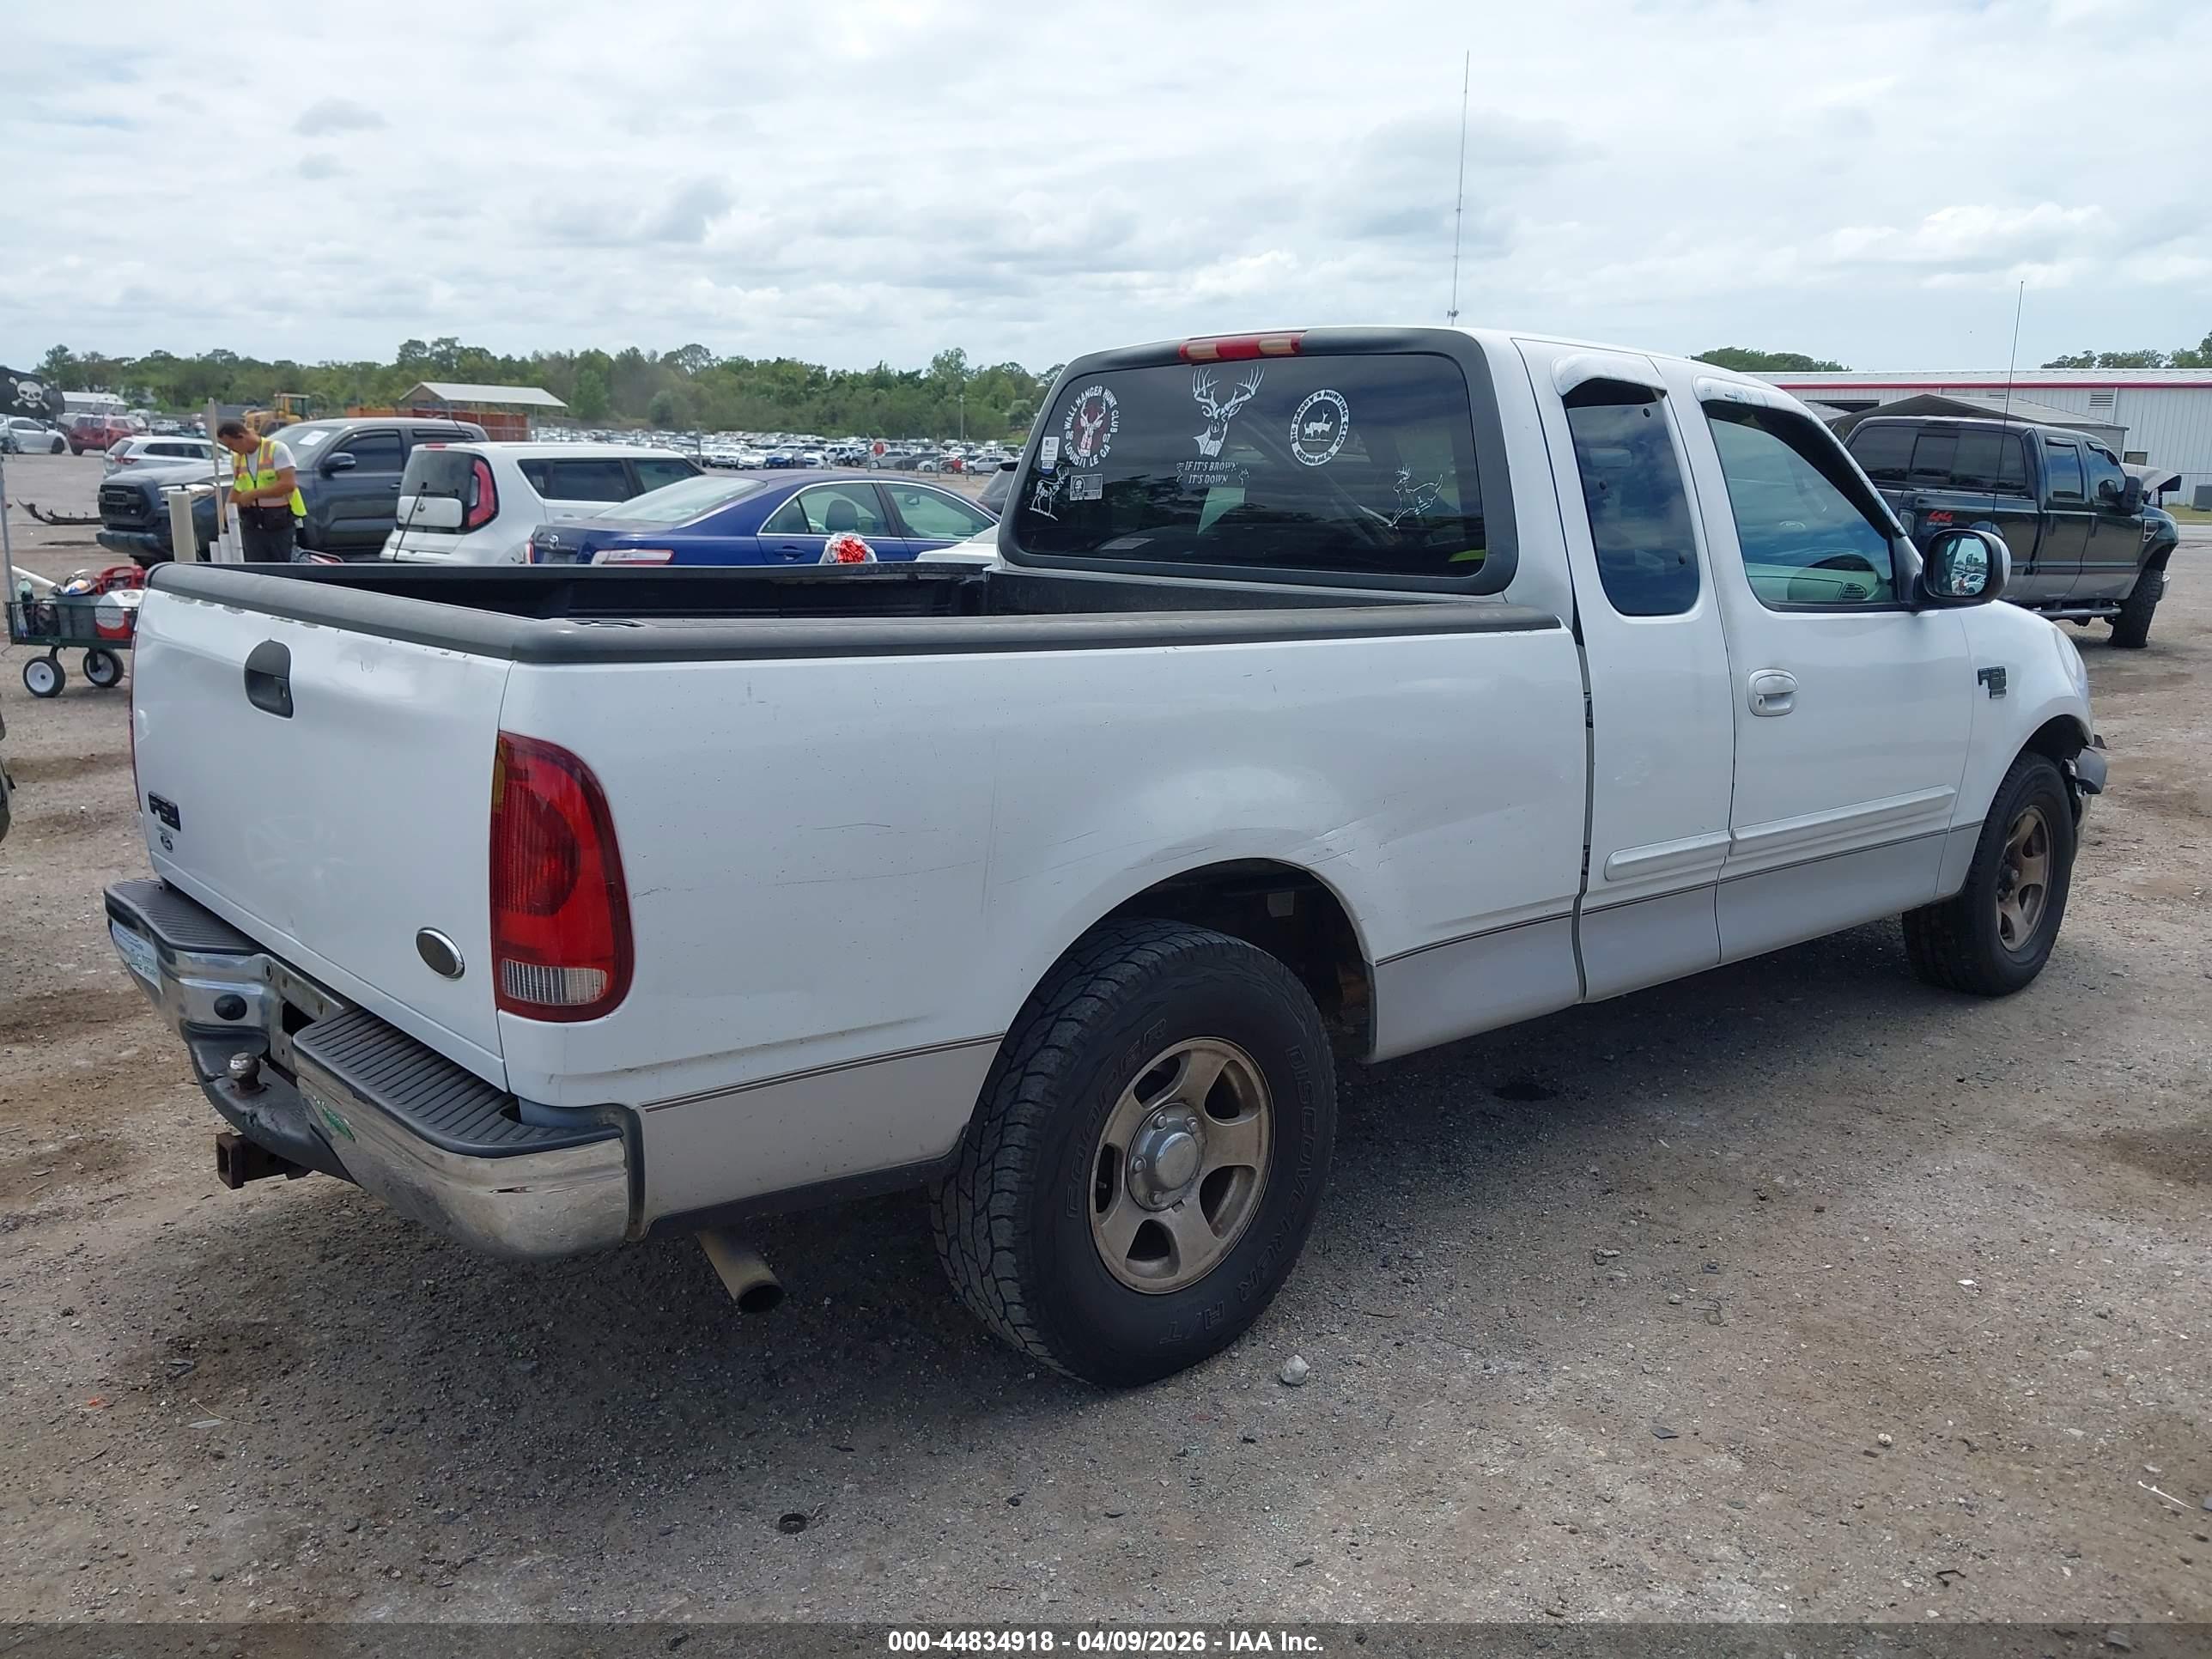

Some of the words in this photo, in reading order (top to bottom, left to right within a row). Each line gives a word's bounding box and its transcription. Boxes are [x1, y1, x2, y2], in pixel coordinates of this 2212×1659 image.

[1064, 405, 1078, 429] WALL
[1076, 385, 1103, 407] HANGER
[1103, 389, 1117, 408] HUNT
[1110, 410, 1119, 433] CLUB
[1324, 391, 1348, 418] HUNTING
[1336, 421, 1348, 447] CLUB
[1066, 430, 1074, 440] 06
[1100, 444, 1111, 458] GA
[1185, 461, 1194, 471] IF
[1194, 462, 1208, 471] IT'S
[1188, 474, 1203, 484] IT'S
[1205, 474, 1229, 484] DOWN
[1237, 1044, 1317, 1301] DISCOVERER
[1160, 1299, 1224, 1346] A/T
